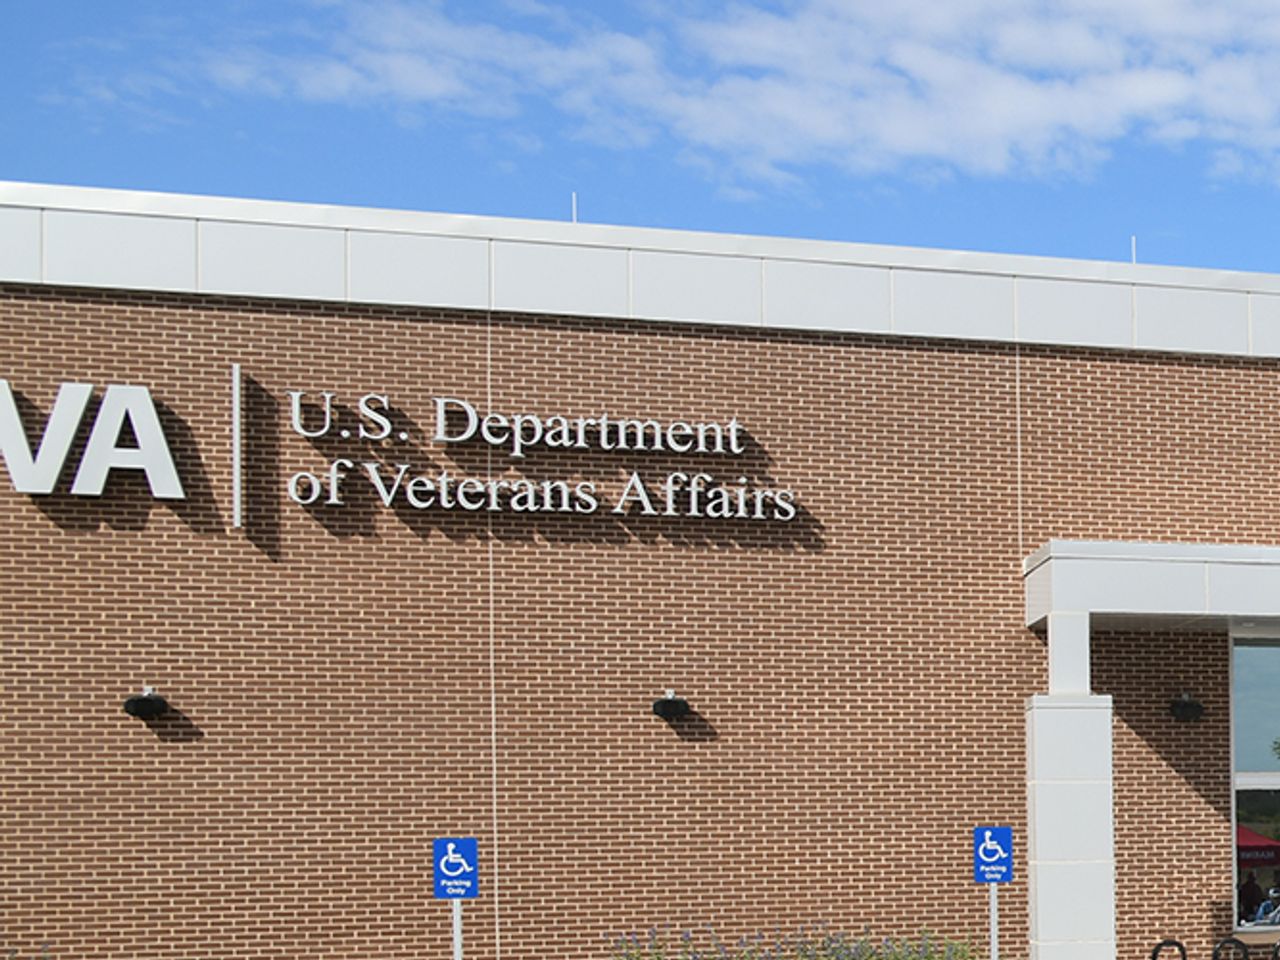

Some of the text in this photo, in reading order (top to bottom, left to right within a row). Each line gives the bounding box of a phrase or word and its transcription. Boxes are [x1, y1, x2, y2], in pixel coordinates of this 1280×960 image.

[0, 379, 186, 499] VA
[286, 390, 745, 458] U.S. Department
[287, 459, 797, 521] of Veterans Affairs
[441, 880, 471, 888] Parking
